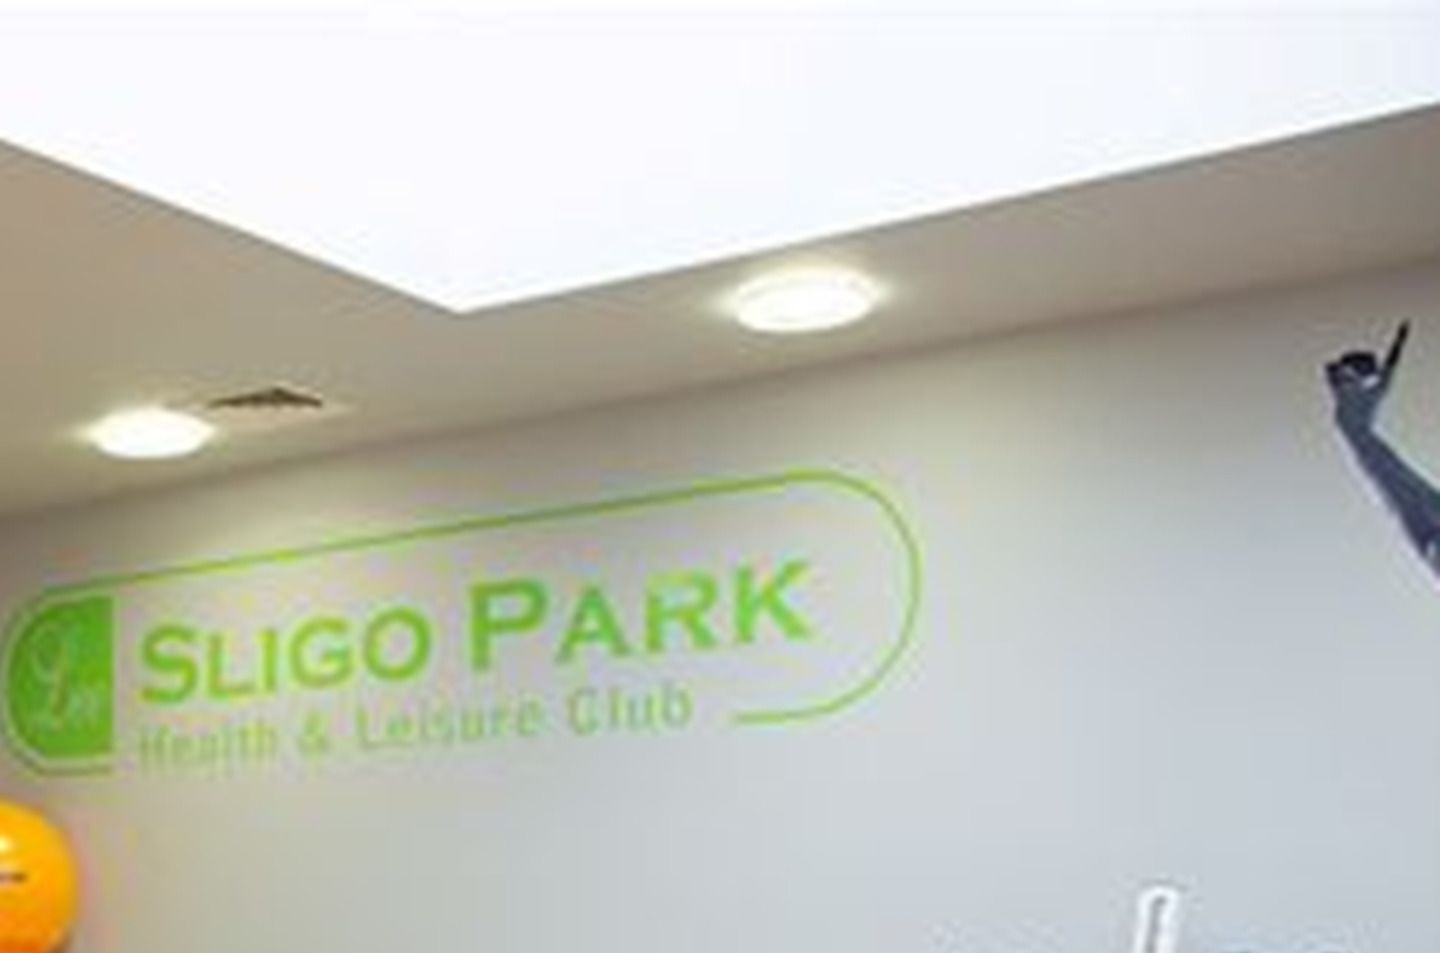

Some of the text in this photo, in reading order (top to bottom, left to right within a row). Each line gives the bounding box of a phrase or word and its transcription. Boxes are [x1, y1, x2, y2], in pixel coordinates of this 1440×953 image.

[139, 608, 432, 706] SLIGO
[469, 557, 812, 674] PARK
[140, 683, 693, 776] Health & Leisure Club
